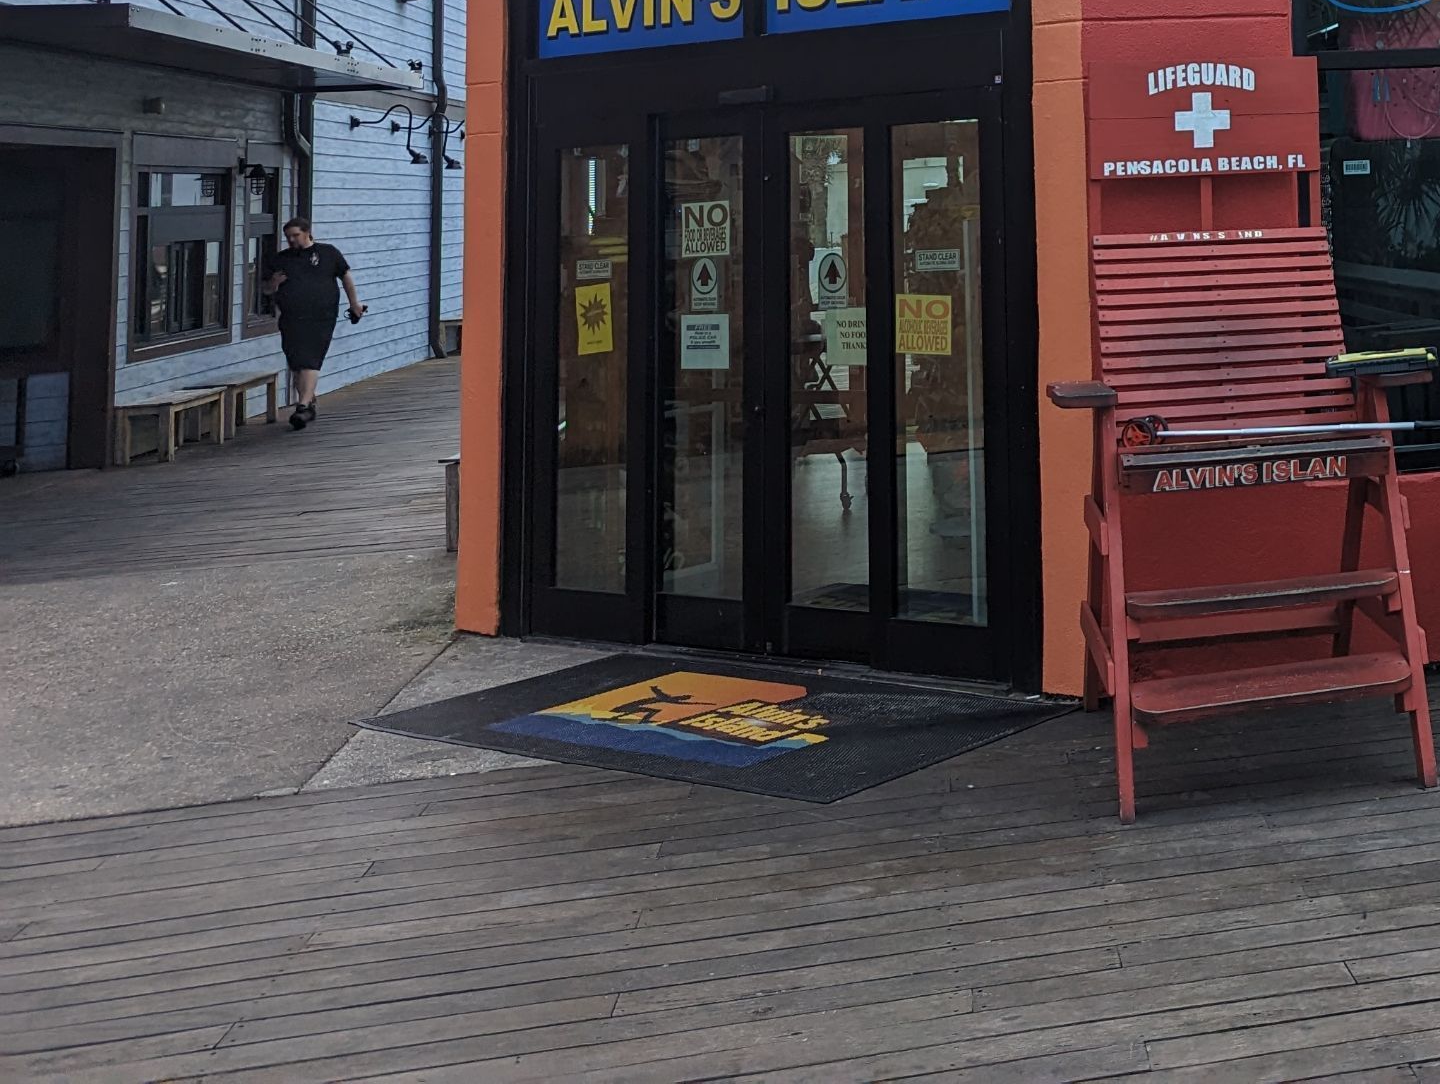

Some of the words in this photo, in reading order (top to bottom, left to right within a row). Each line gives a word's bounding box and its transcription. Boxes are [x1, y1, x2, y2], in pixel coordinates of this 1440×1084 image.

[1147, 62, 1256, 96] LIFEGUARD
[1104, 159, 1213, 176] PENSACOLA
[1217, 155, 1284, 173] BEACH,
[1288, 154, 1306, 169] FL
[684, 203, 729, 228] NO
[685, 241, 727, 255] ALLOWED
[938, 252, 957, 260] CLEAR
[898, 299, 950, 320] NO
[836, 320, 847, 328] NO
[840, 331, 850, 339] NO
[898, 334, 948, 351] ALLOWED
[1152, 463, 1258, 493] ALVIN'S
[678, 713, 799, 742] Island
